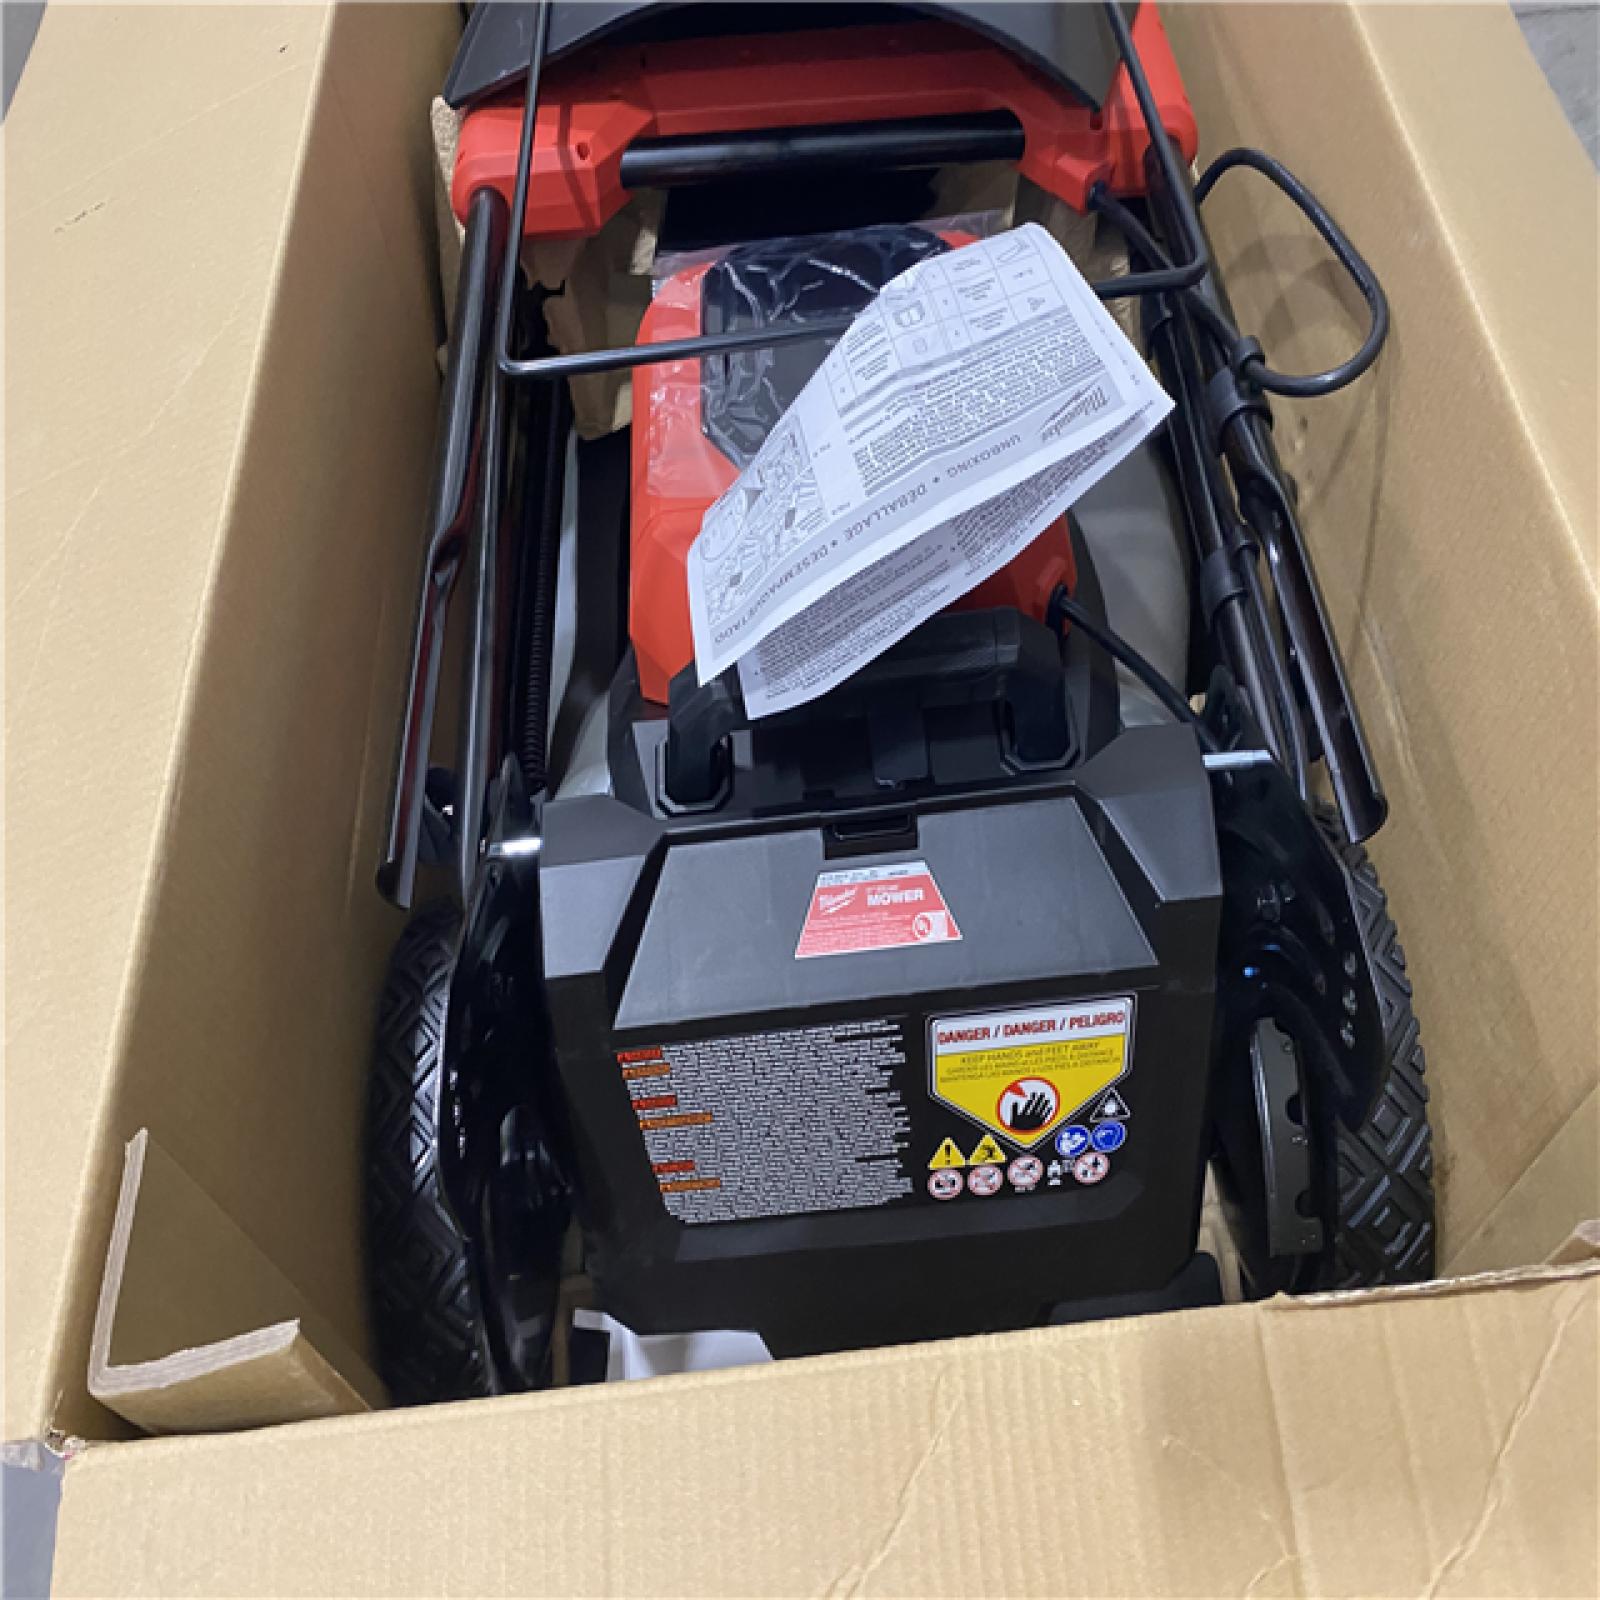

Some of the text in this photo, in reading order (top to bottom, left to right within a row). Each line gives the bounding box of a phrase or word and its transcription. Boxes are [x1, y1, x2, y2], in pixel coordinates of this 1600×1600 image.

[946, 434, 1021, 479] UNBOXING
[714, 545, 829, 644] DESEMPAQUETADO
[867, 887, 924, 907] MOWER
[937, 1026, 991, 1045] DANGER
[1002, 1018, 1056, 1038] DANGER
[1069, 1010, 1126, 1030] PELIGRO
[986, 1051, 1023, 1062] HANDS
